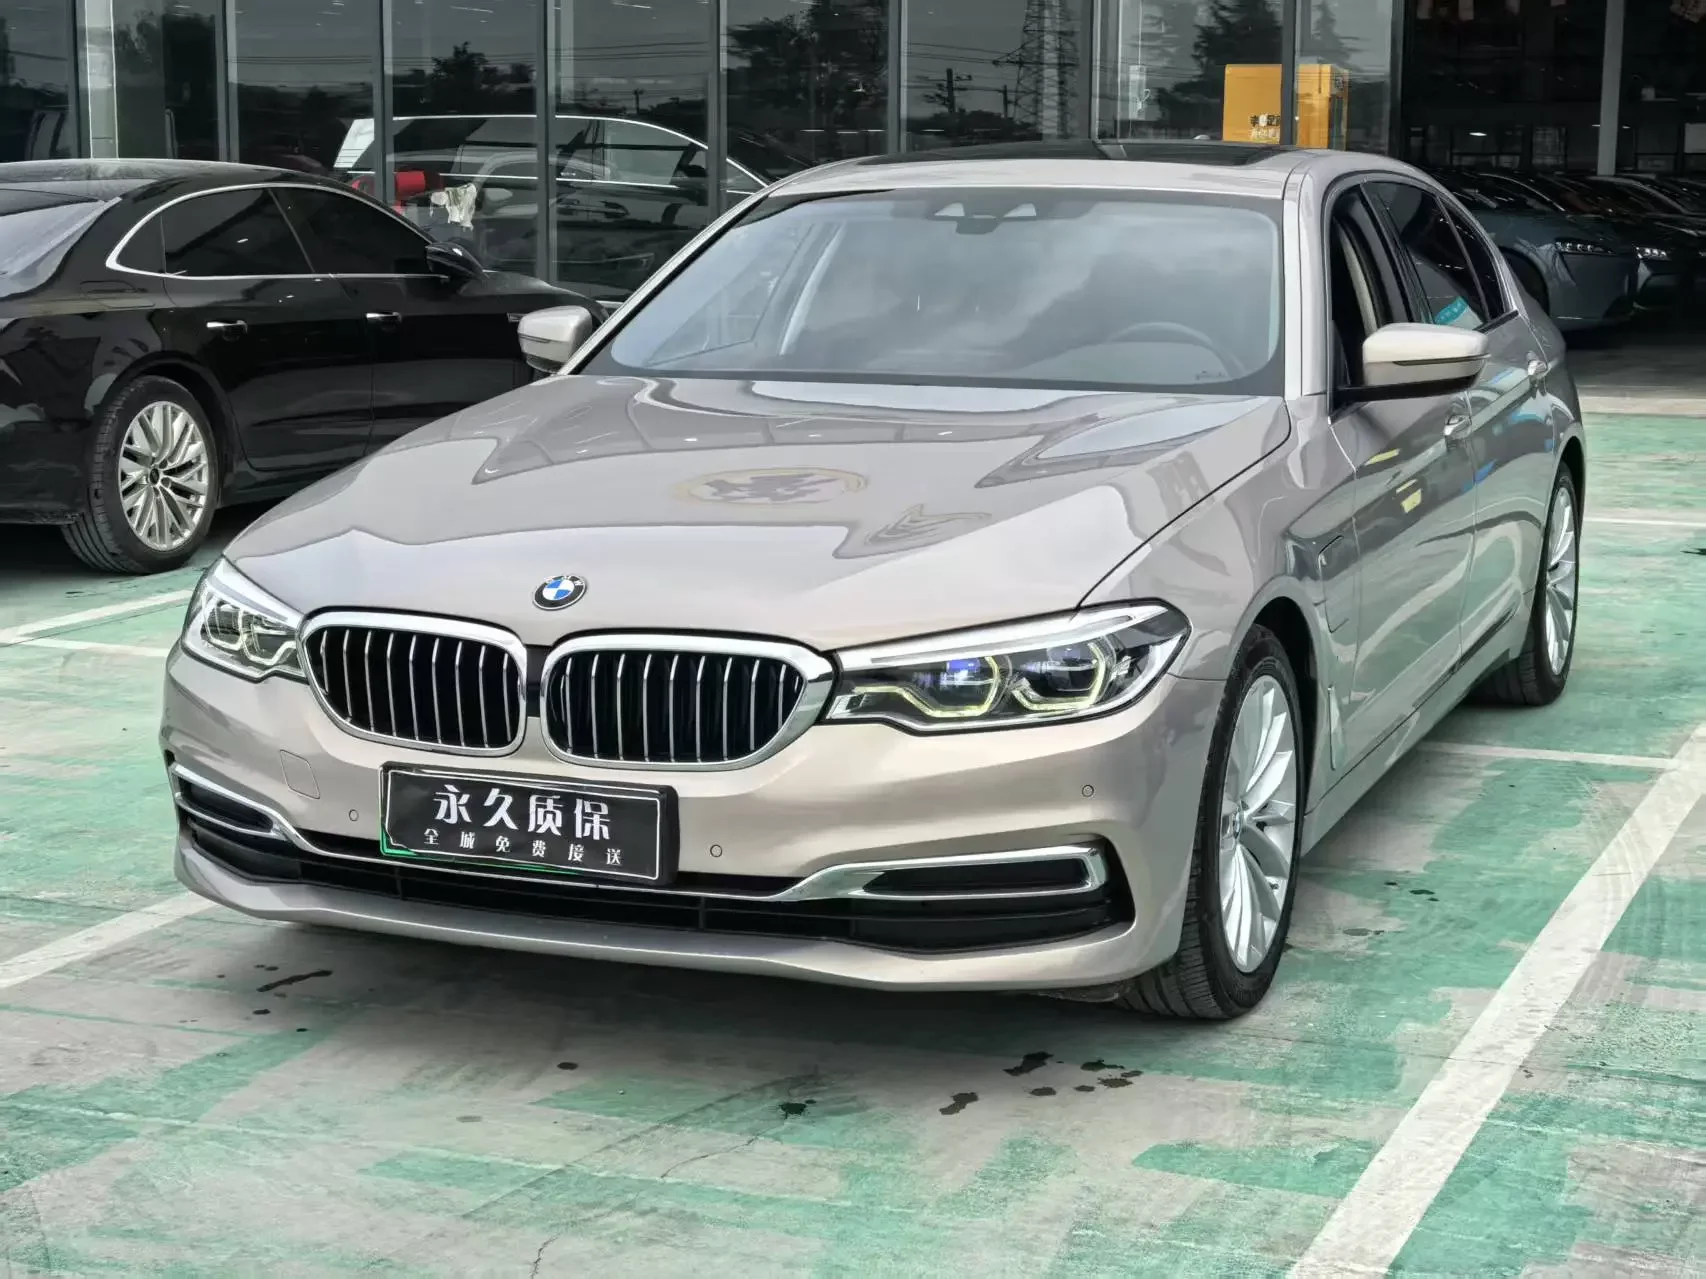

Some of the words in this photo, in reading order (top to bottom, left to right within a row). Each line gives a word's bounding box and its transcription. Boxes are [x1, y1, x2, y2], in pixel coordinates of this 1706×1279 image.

[433, 785, 611, 840] 永久质保
[423, 828, 622, 865] 全城免费接送
